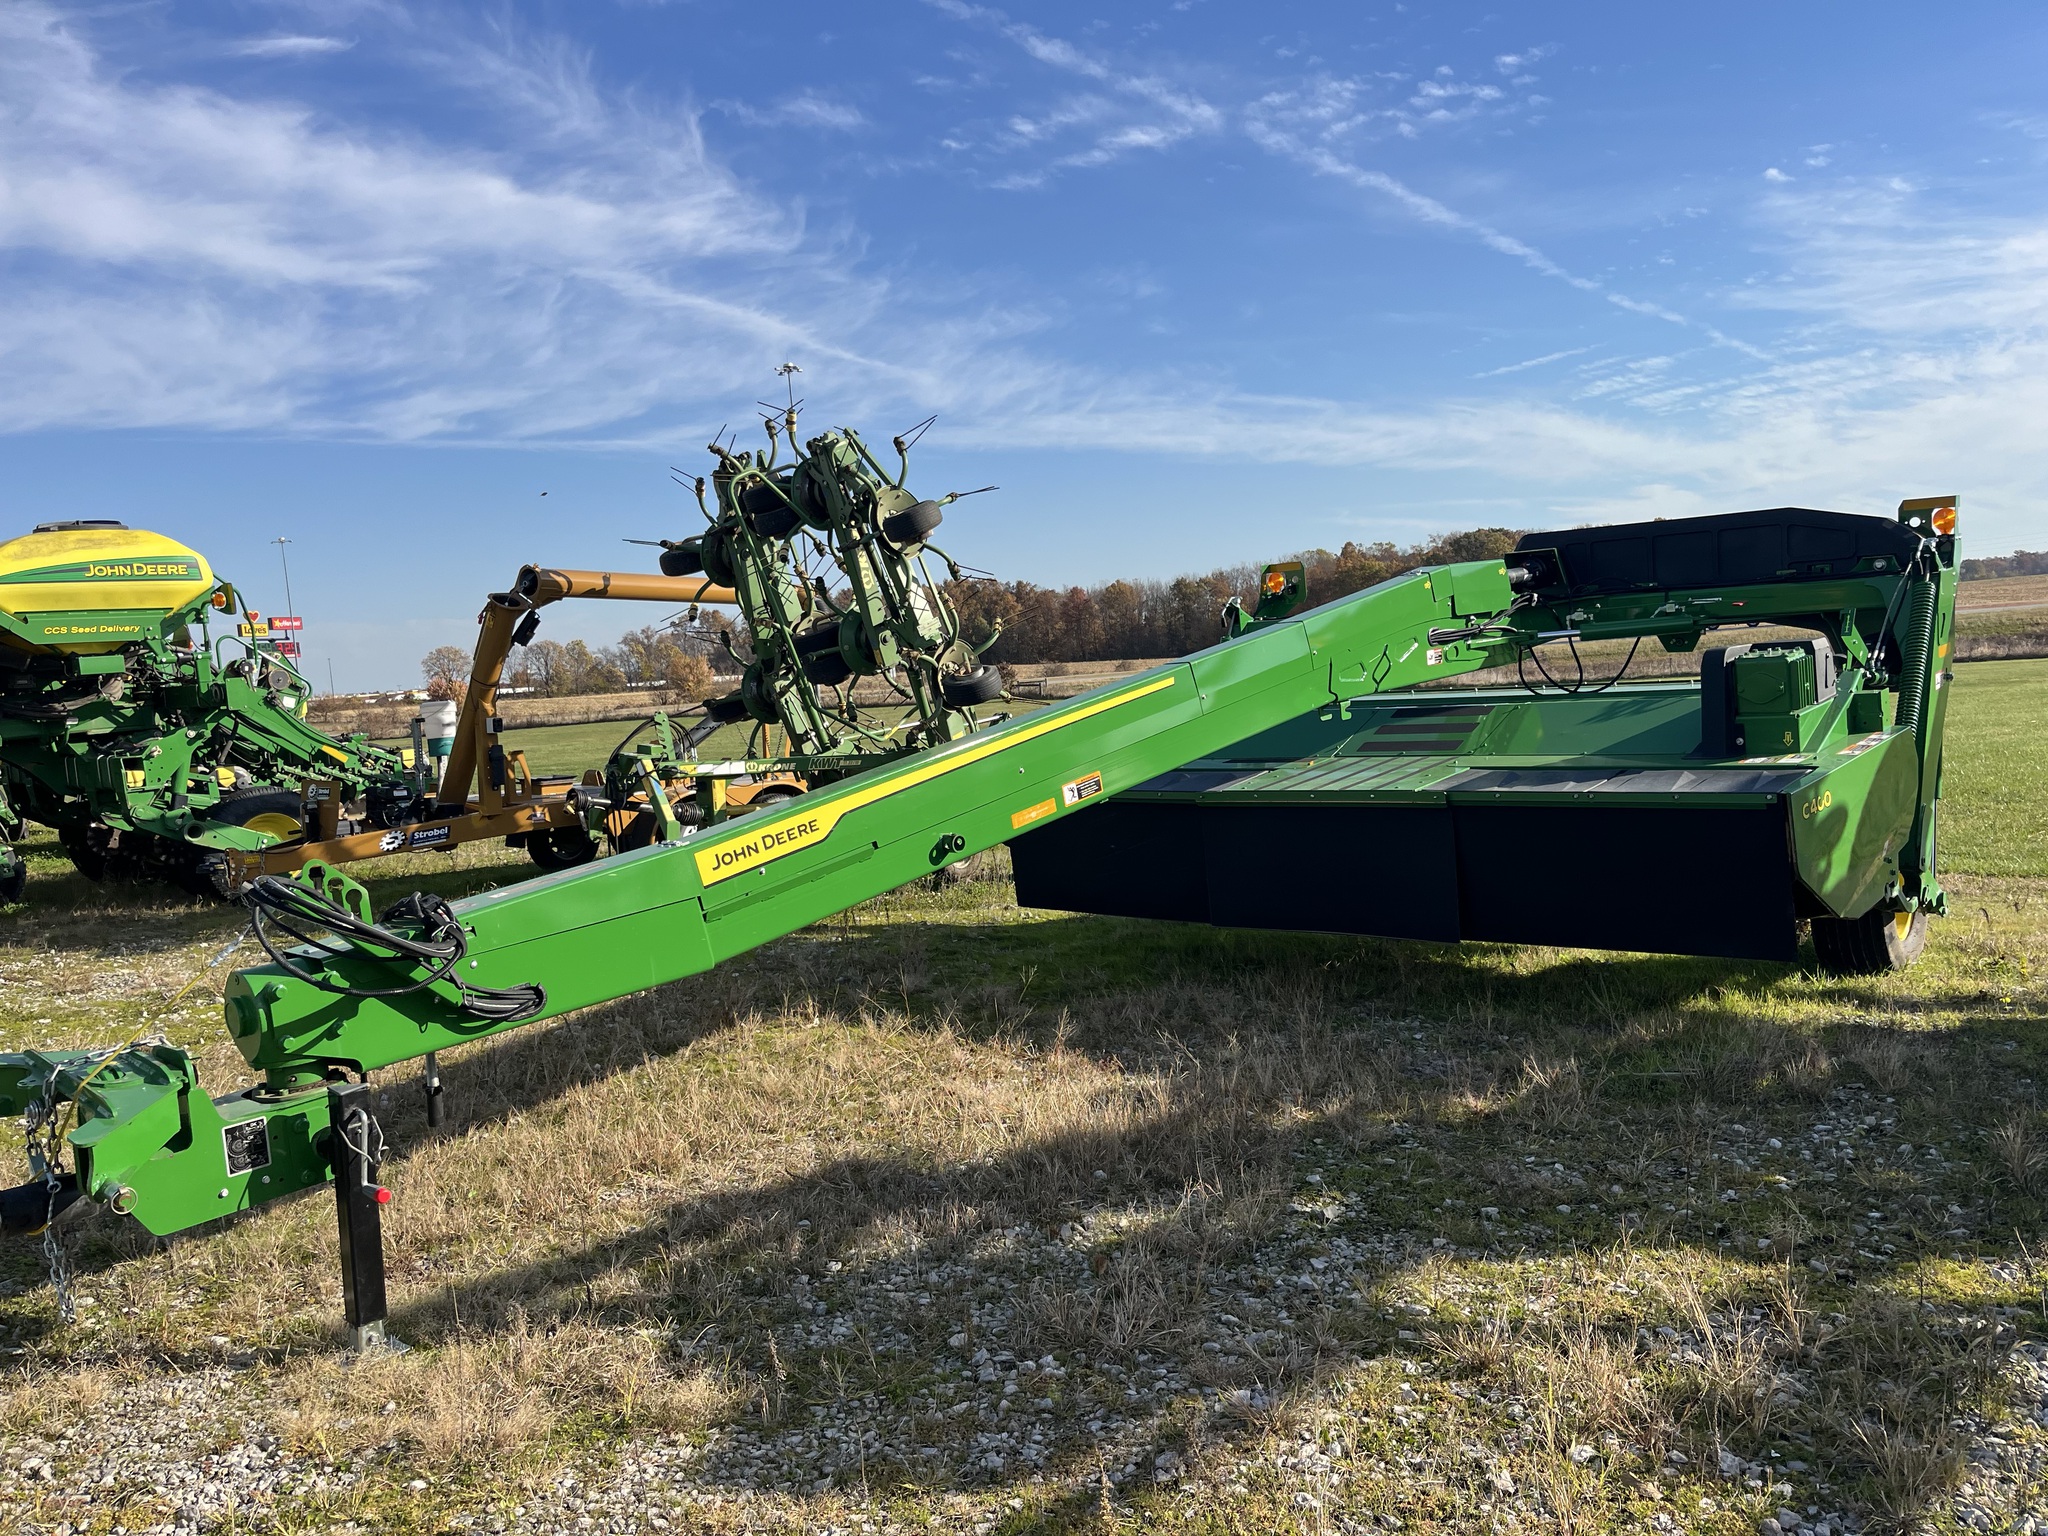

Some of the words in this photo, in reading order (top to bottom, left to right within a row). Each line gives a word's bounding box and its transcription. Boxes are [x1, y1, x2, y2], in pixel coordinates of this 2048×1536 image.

[84, 563, 132, 578] JOHN
[133, 562, 188, 576] DEERE
[44, 626, 68, 635] CCS
[70, 625, 97, 635] Seed
[99, 624, 141, 635] Delivery
[758, 762, 797, 772] KRONE
[808, 756, 845, 770] KWT
[1802, 789, 1832, 820] C400
[413, 826, 448, 840] Strobel
[712, 841, 760, 872] JOHN
[761, 818, 820, 851] DEERE
